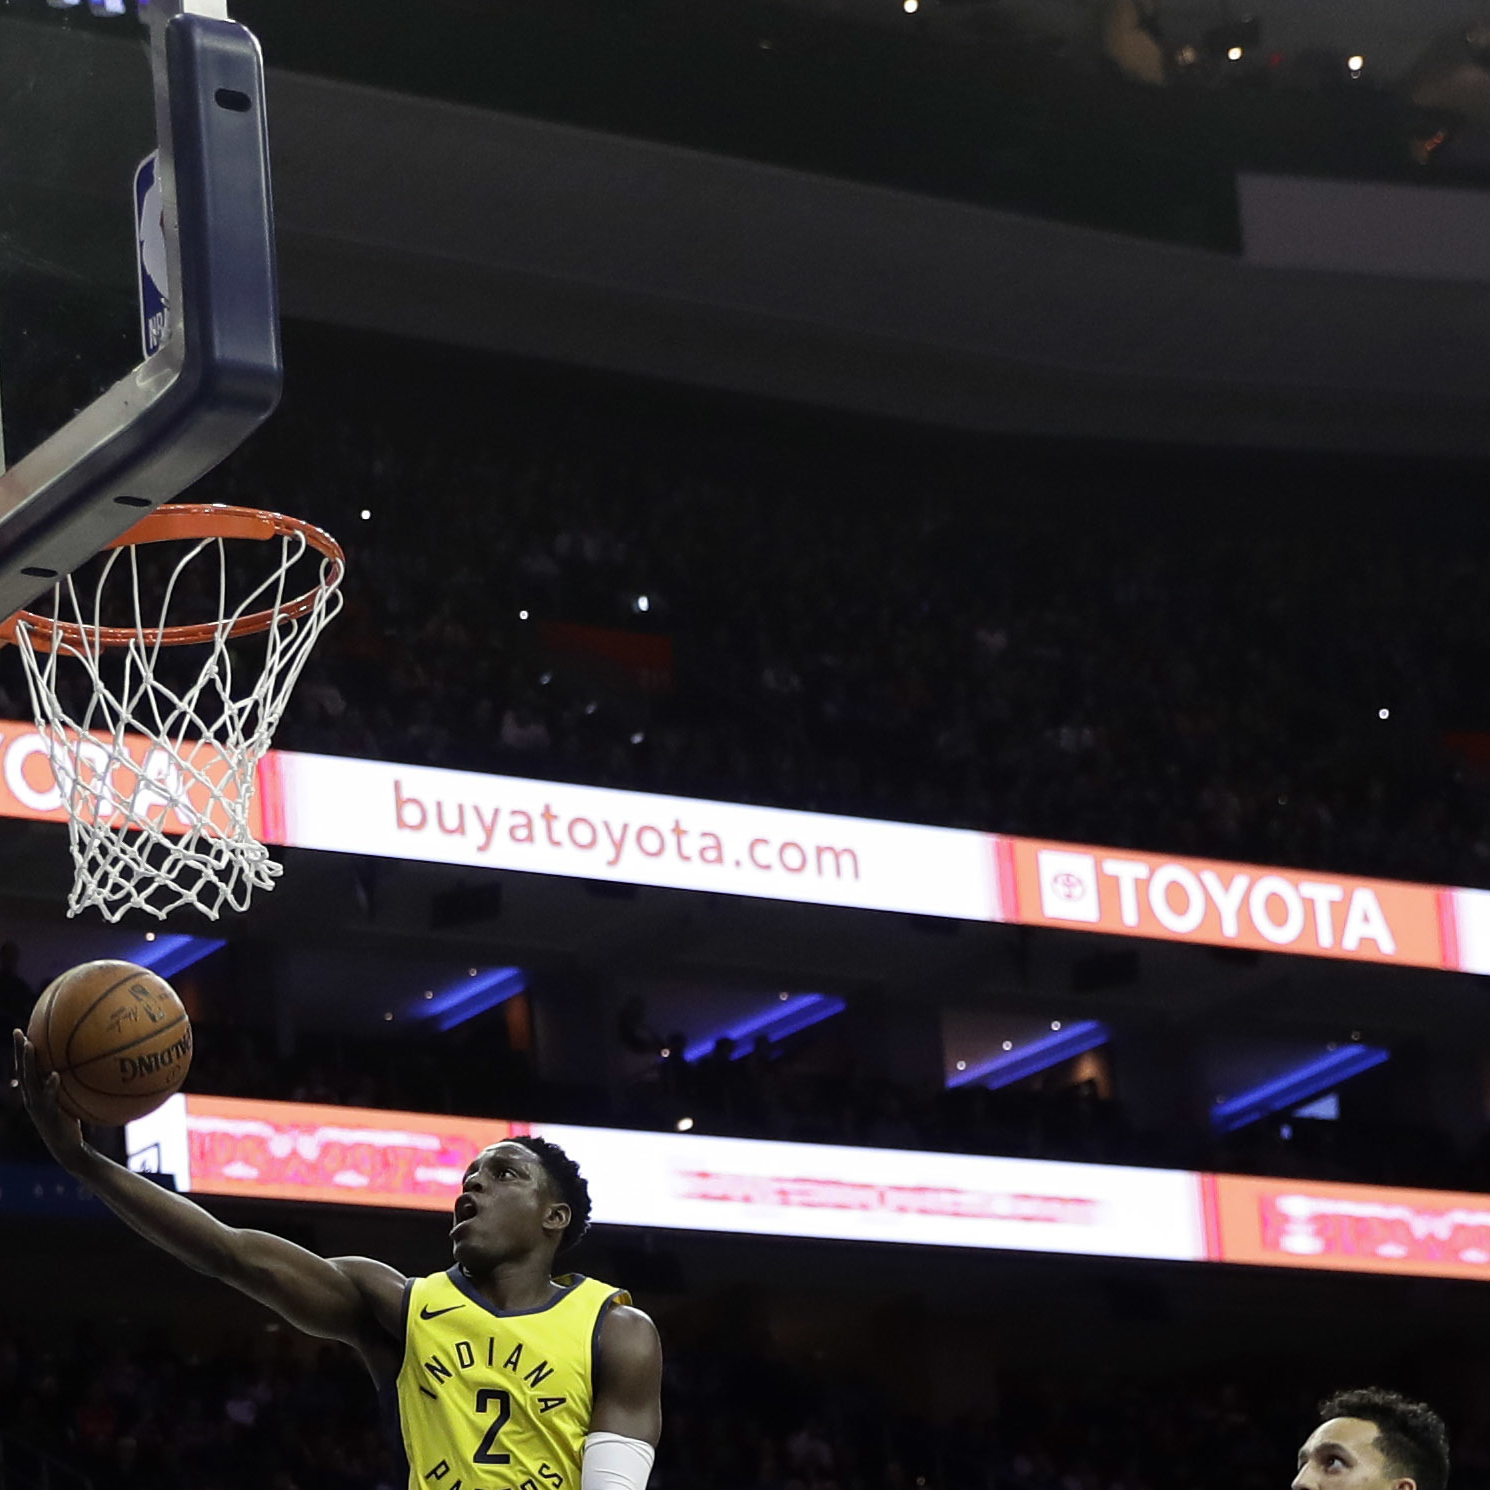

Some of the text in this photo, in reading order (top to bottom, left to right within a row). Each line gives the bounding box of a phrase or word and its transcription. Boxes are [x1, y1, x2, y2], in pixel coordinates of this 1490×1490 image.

[392, 778, 861, 881] buyatoyota.com
[1101, 857, 1397, 956] TOYOTA
[419, 1336, 567, 1414] INDIANA
[472, 1388, 511, 1465] 2
